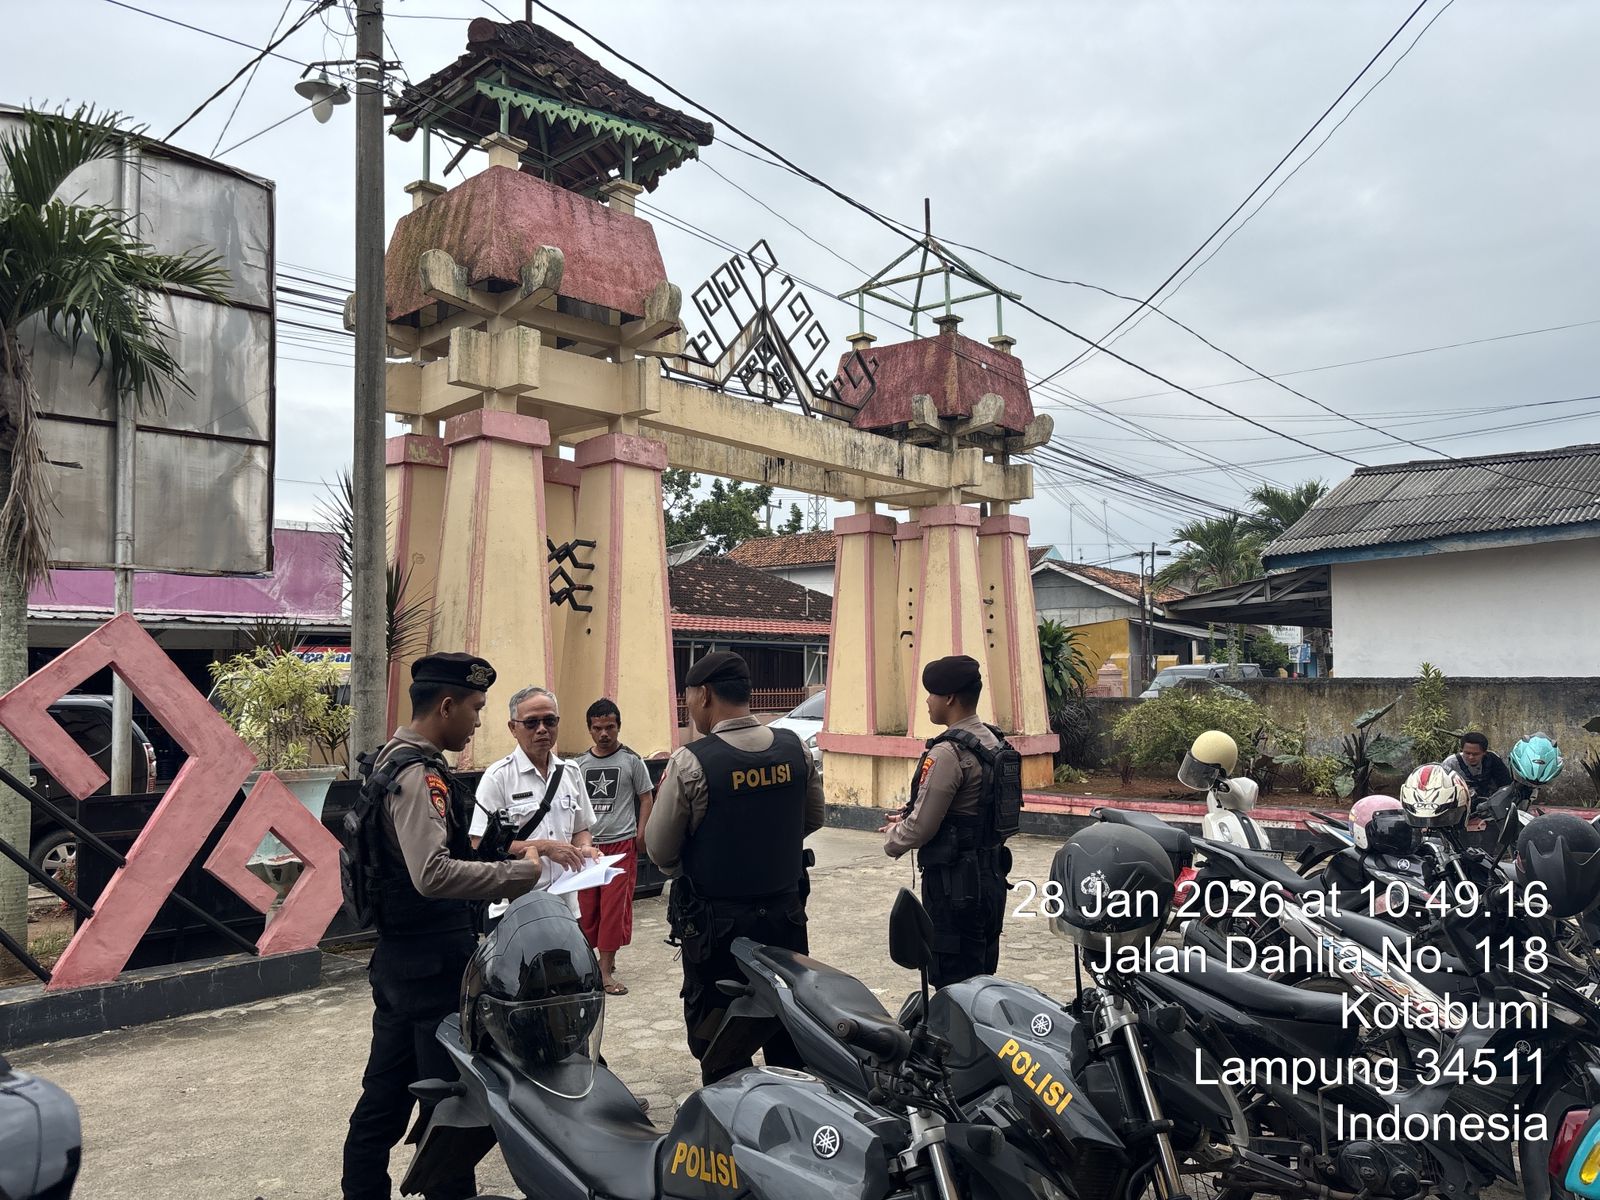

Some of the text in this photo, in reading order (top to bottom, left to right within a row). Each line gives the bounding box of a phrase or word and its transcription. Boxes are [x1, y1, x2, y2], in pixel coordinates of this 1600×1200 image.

[732, 763, 791, 790] POLISI
[997, 1038, 1073, 1115] POLISI
[671, 1142, 738, 1189] POLISI
